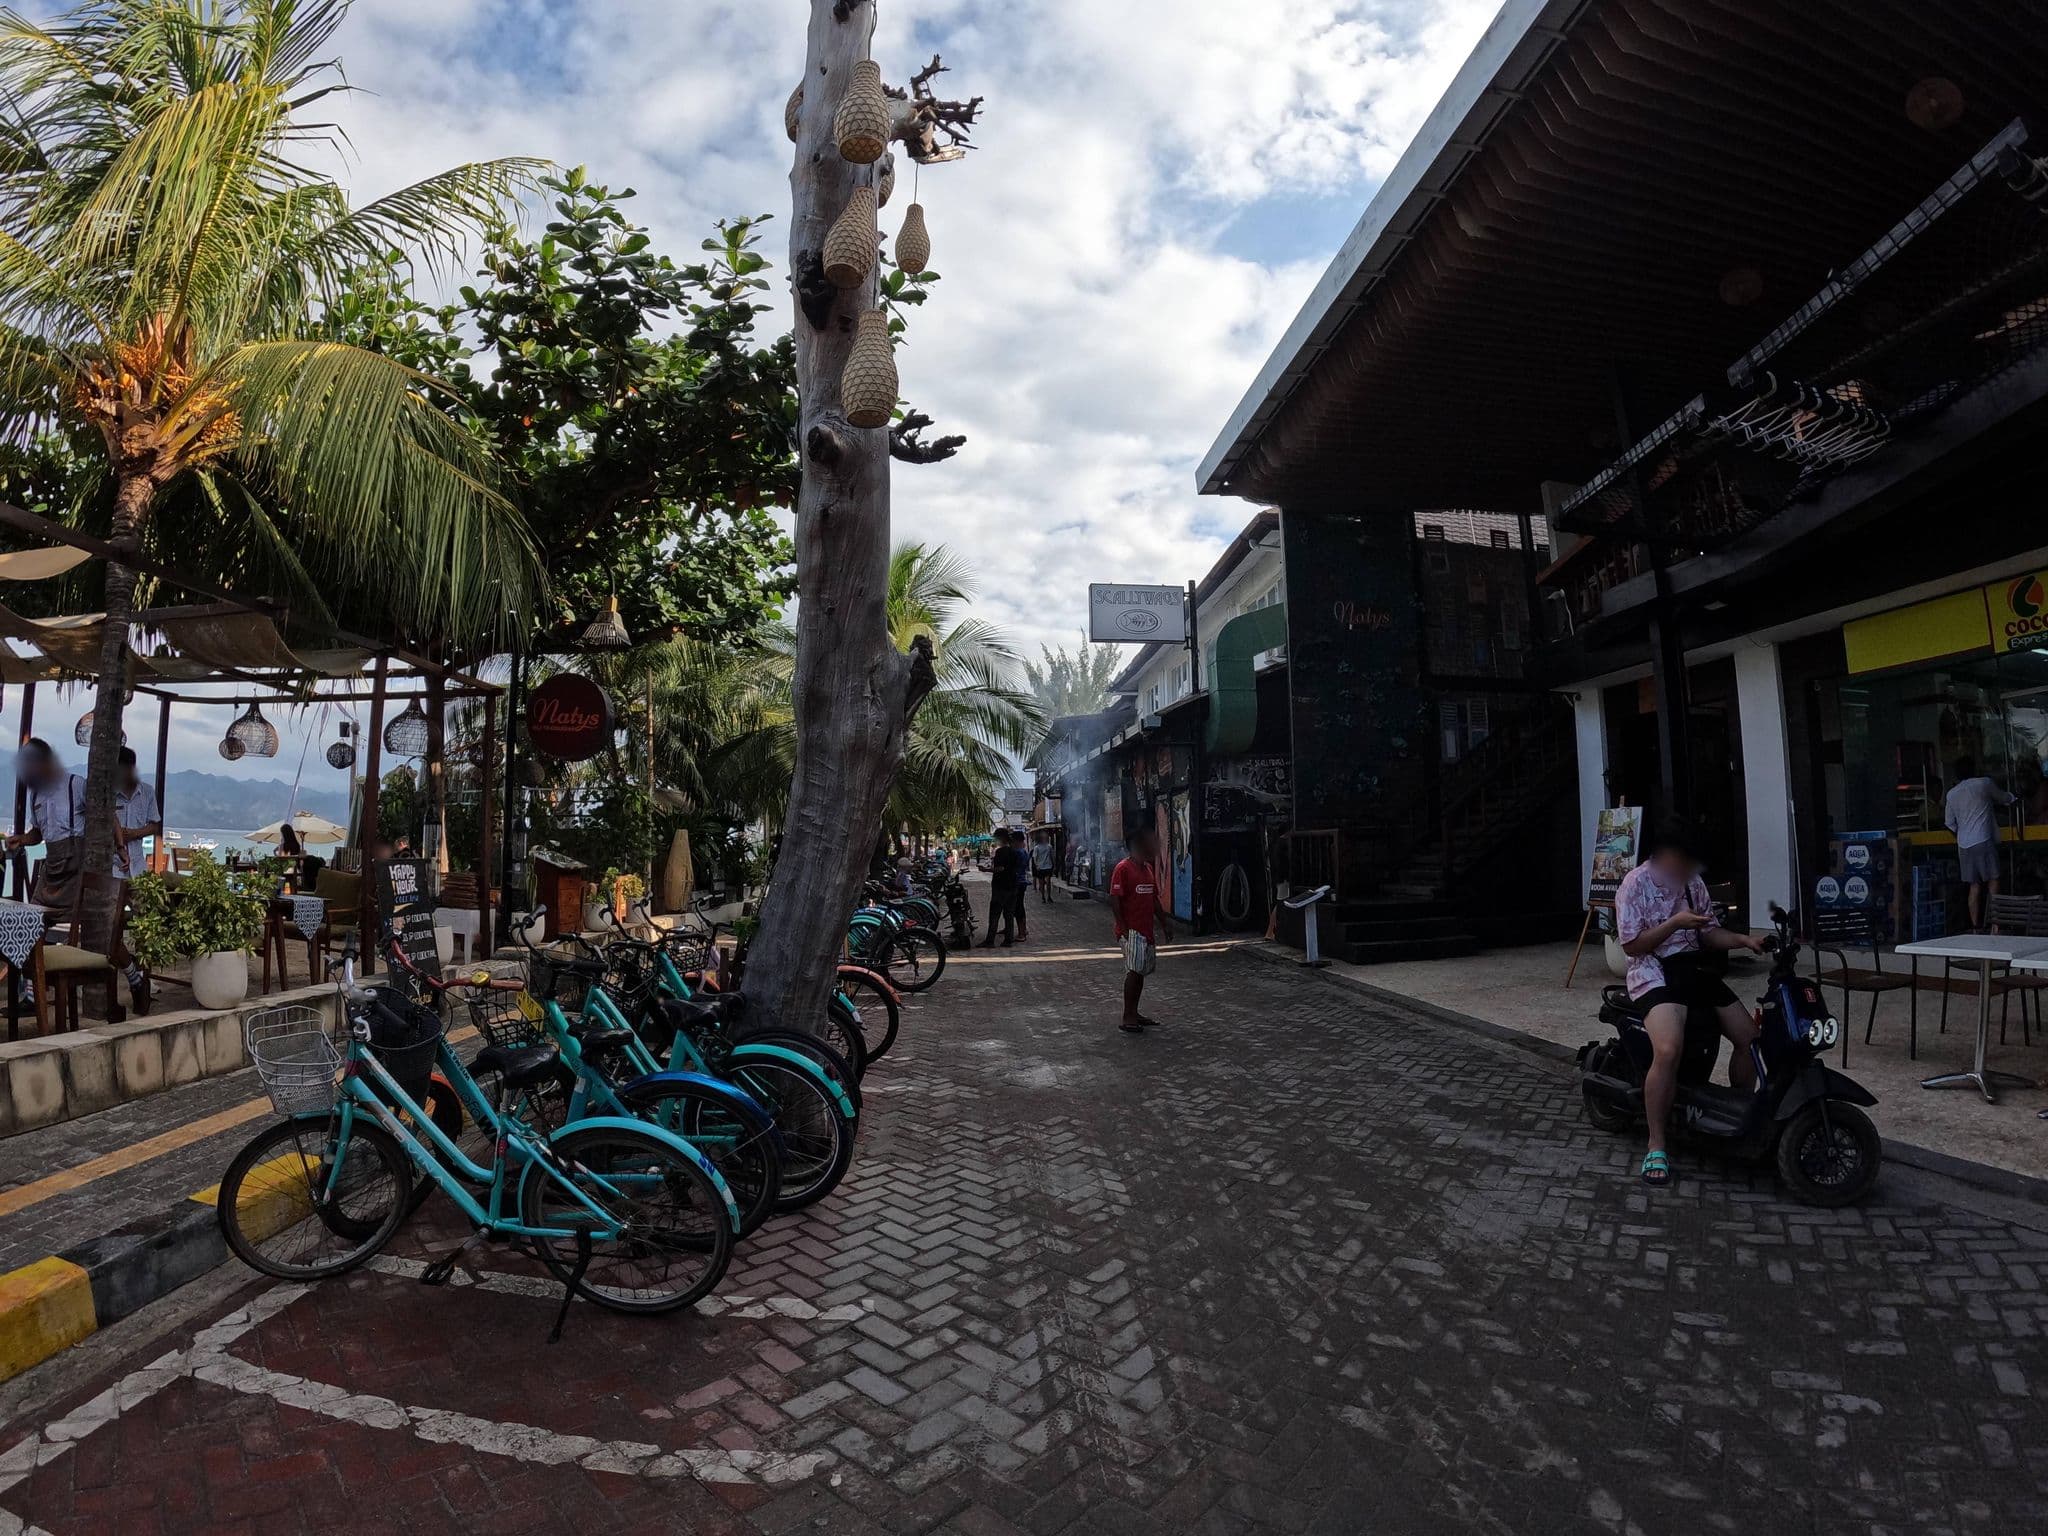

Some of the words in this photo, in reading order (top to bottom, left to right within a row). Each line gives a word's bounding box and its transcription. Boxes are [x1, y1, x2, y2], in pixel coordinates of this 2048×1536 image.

[1095, 589, 1181, 606] SCALLYWAGS
[1334, 600, 1392, 630] Natys
[533, 697, 600, 733] Natys
[1849, 849, 1866, 858] AQUA
[388, 865, 416, 881] HAPPY
[396, 879, 418, 896] HOUR
[1820, 884, 1837, 893] AQUA
[1847, 884, 1865, 894] AQUA
